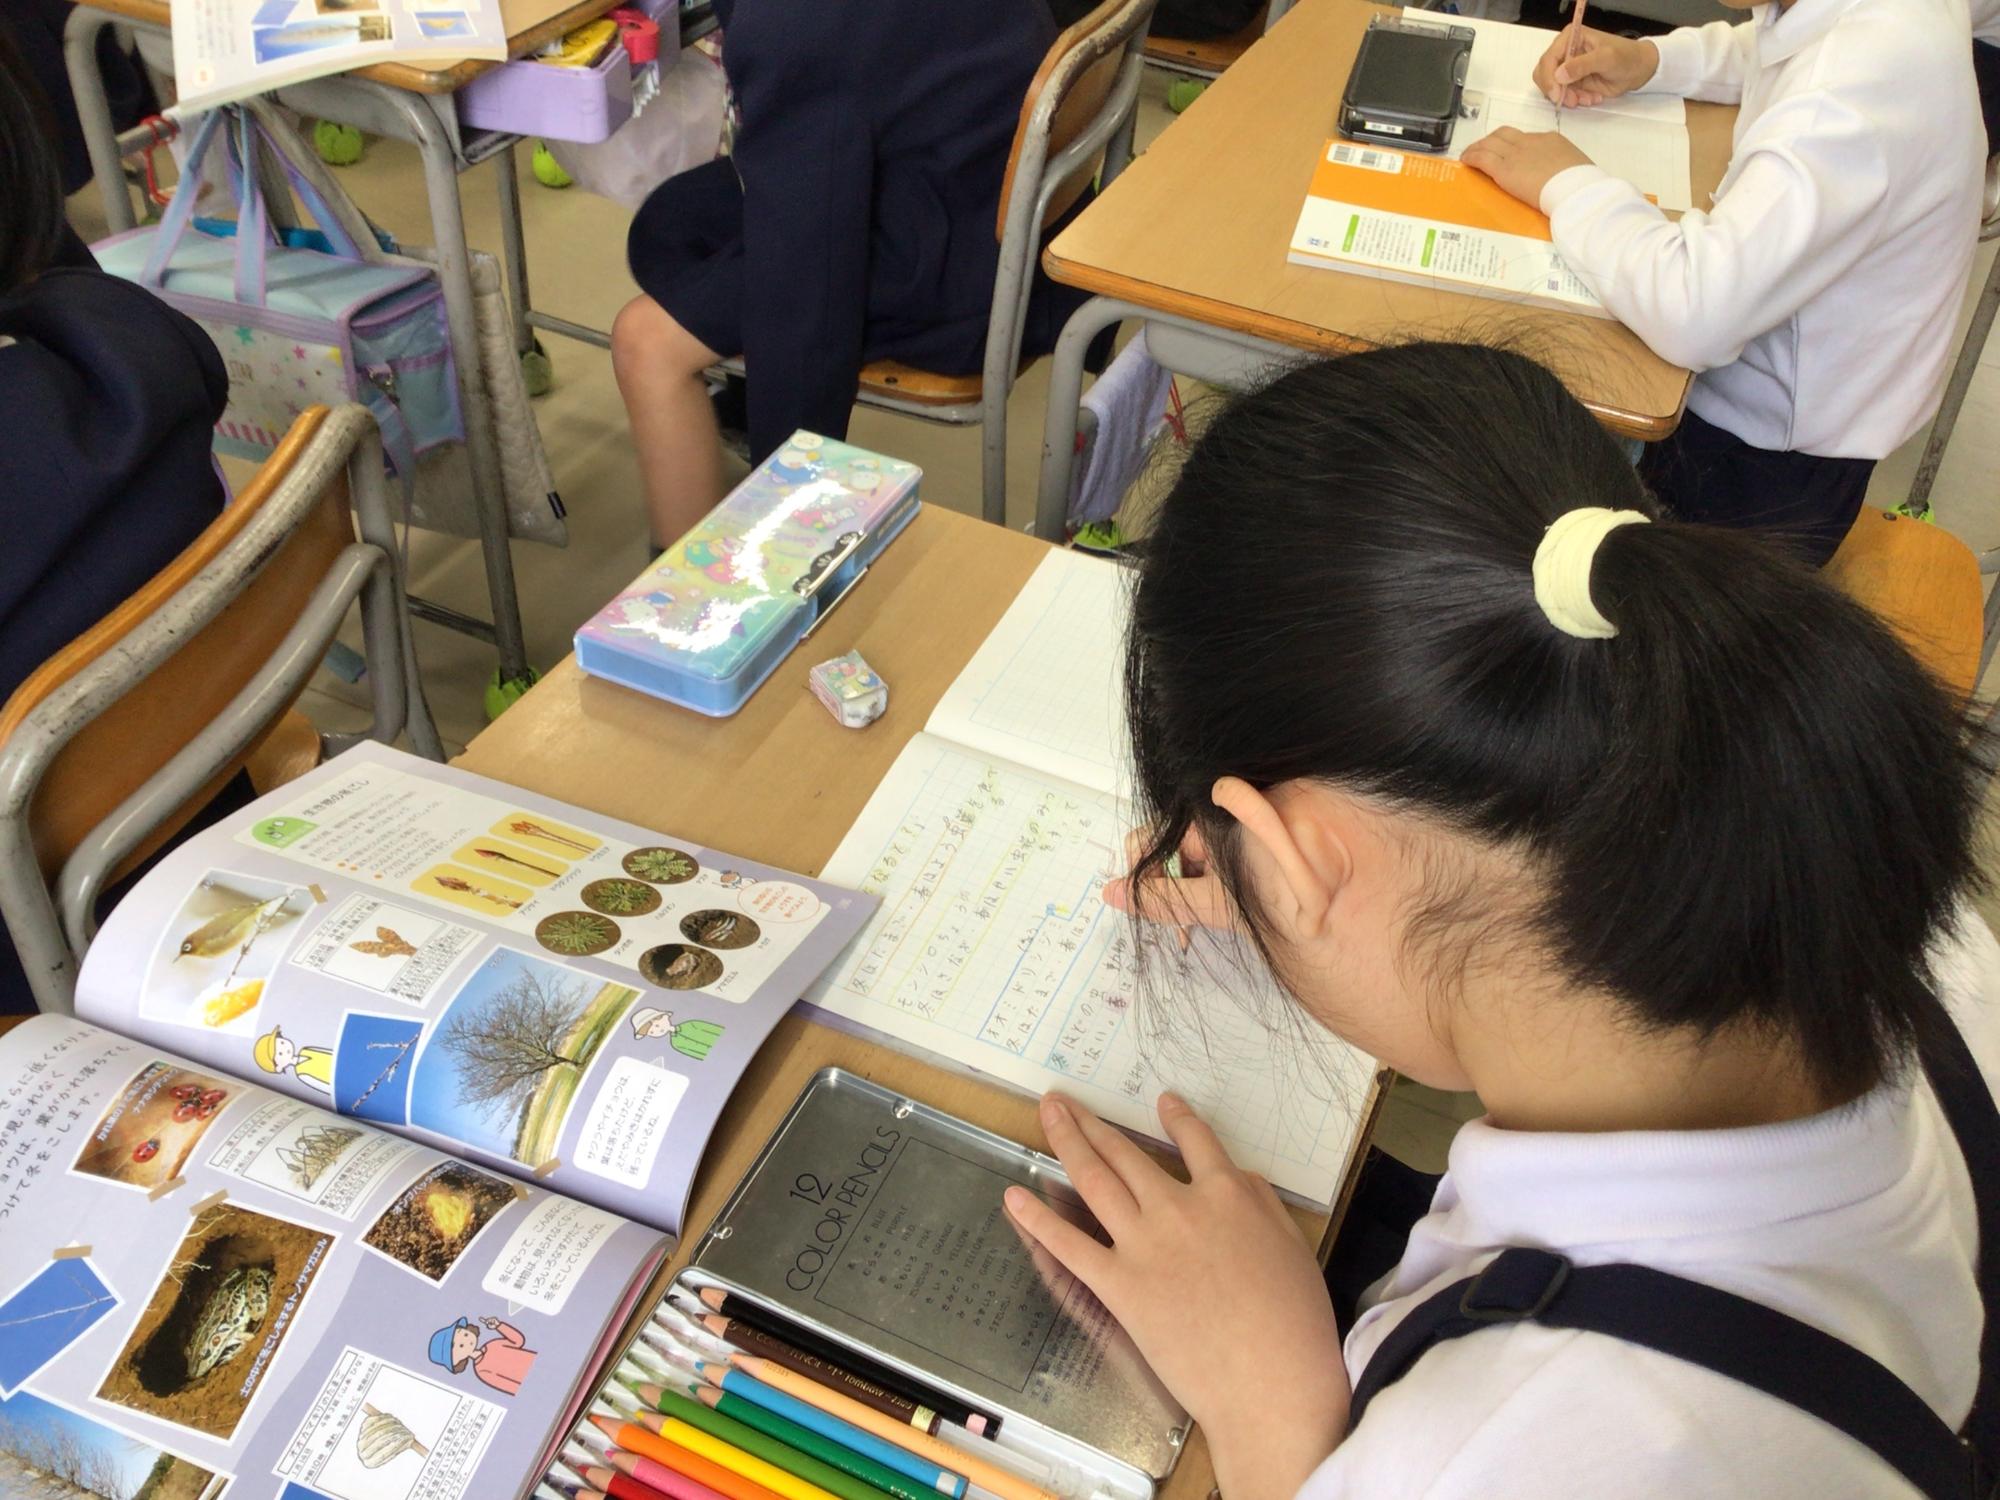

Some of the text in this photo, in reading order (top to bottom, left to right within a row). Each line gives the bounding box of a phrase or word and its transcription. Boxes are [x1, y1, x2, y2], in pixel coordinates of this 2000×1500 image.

[788, 1168, 834, 1207] 12
[785, 1124, 901, 1292] COLOR PENCILS
[932, 1222, 953, 1254] ORANGE
[948, 1229, 969, 1260] YELLOW
[979, 1248, 997, 1275] GREEN
[290, 1370, 344, 1457] オオカマキリのたまご
